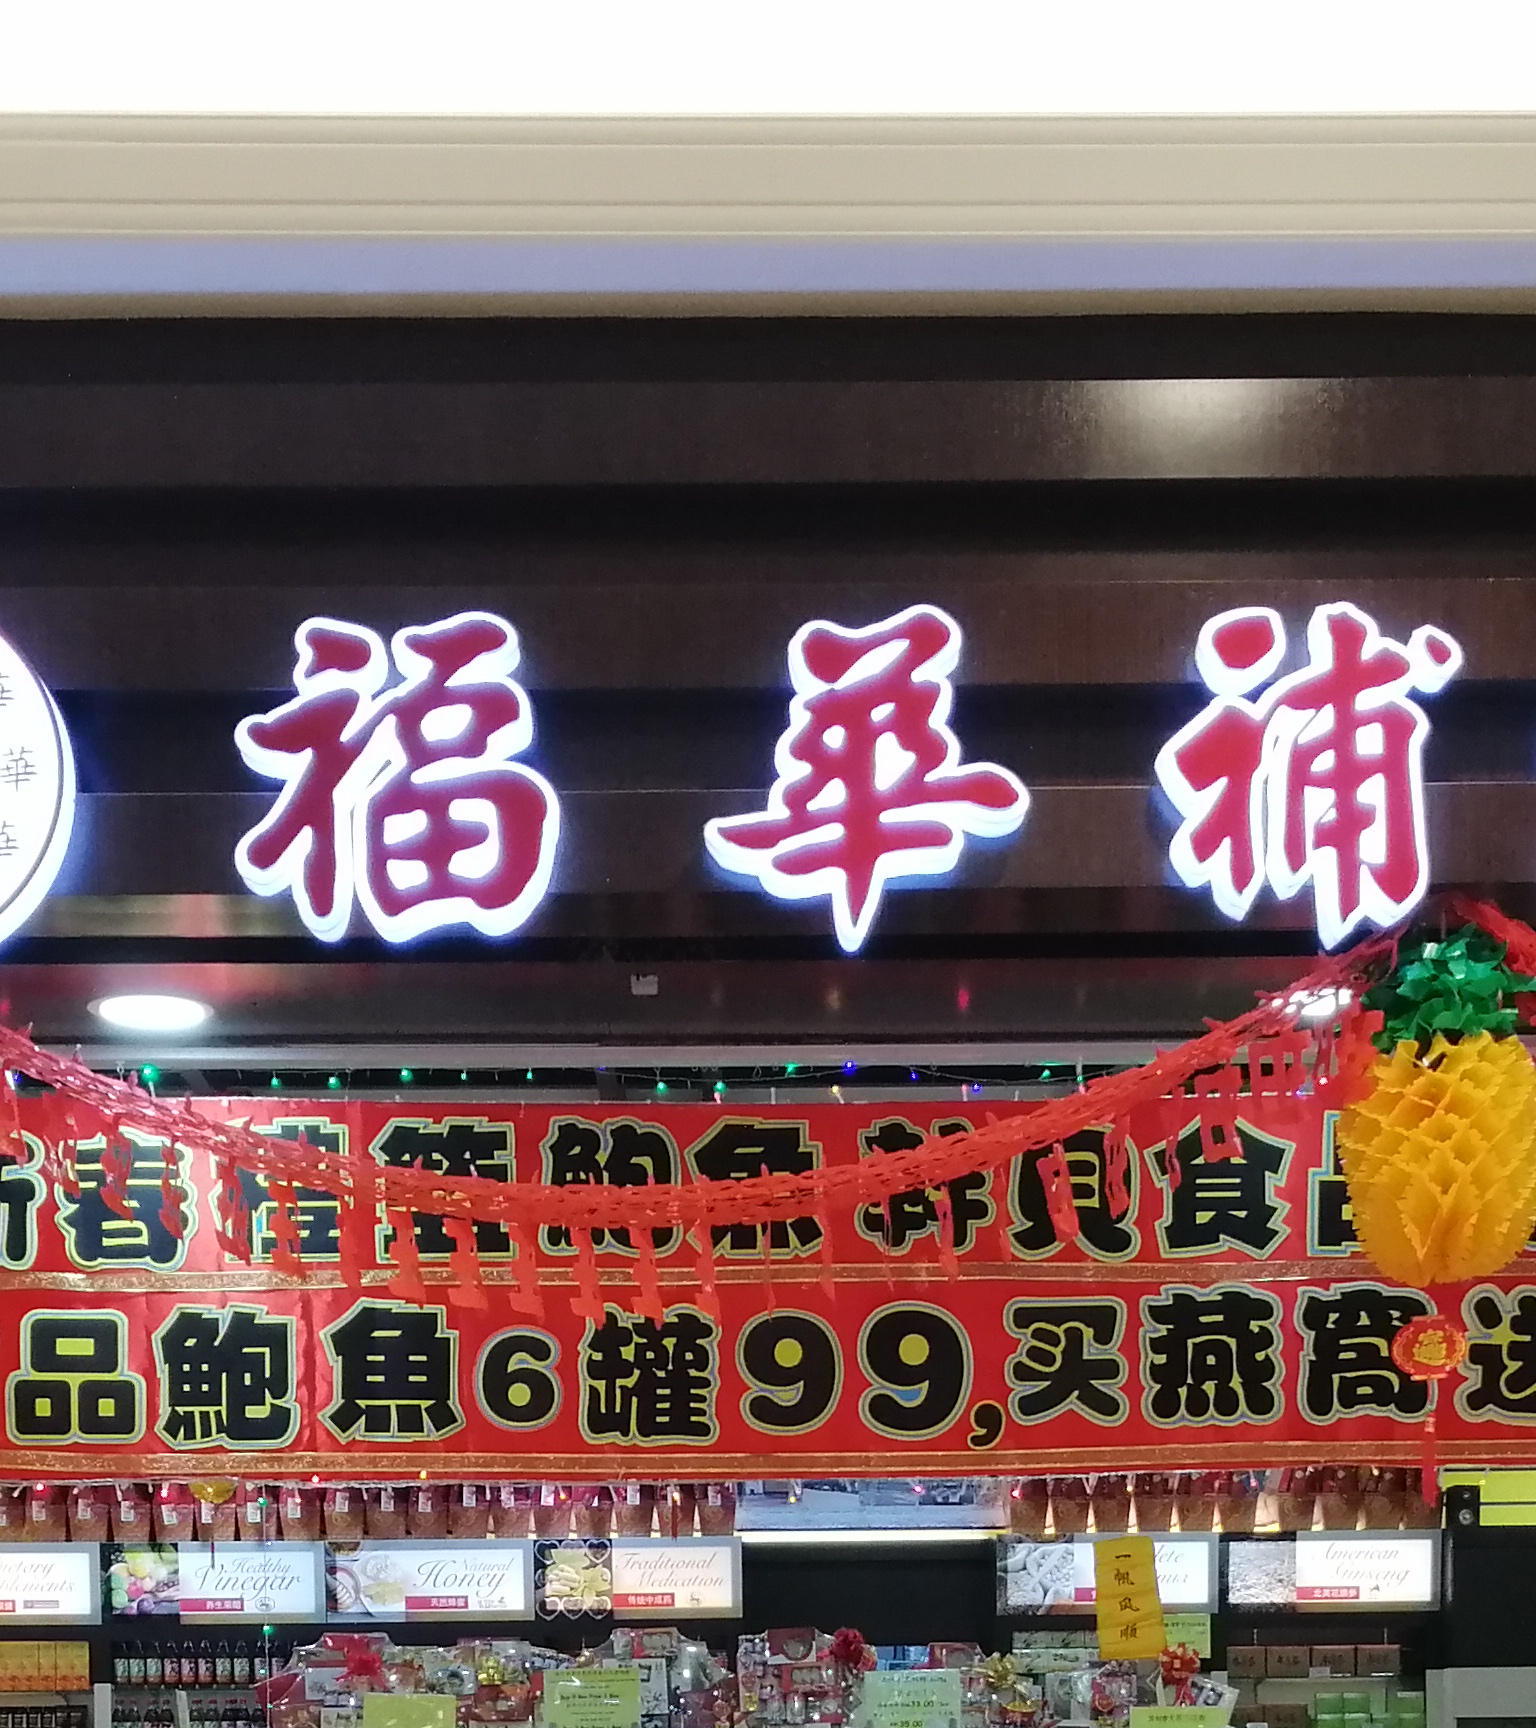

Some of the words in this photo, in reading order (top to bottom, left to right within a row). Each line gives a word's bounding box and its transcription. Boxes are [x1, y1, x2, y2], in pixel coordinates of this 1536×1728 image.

[229, 1557, 293, 1580] Healthy
[462, 1557, 513, 1573] Natural
[616, 1552, 713, 1572] Traditional
[195, 1565, 302, 1600] Vinegar
[413, 1559, 507, 1598] Honey
[633, 1571, 725, 1590] Medication
